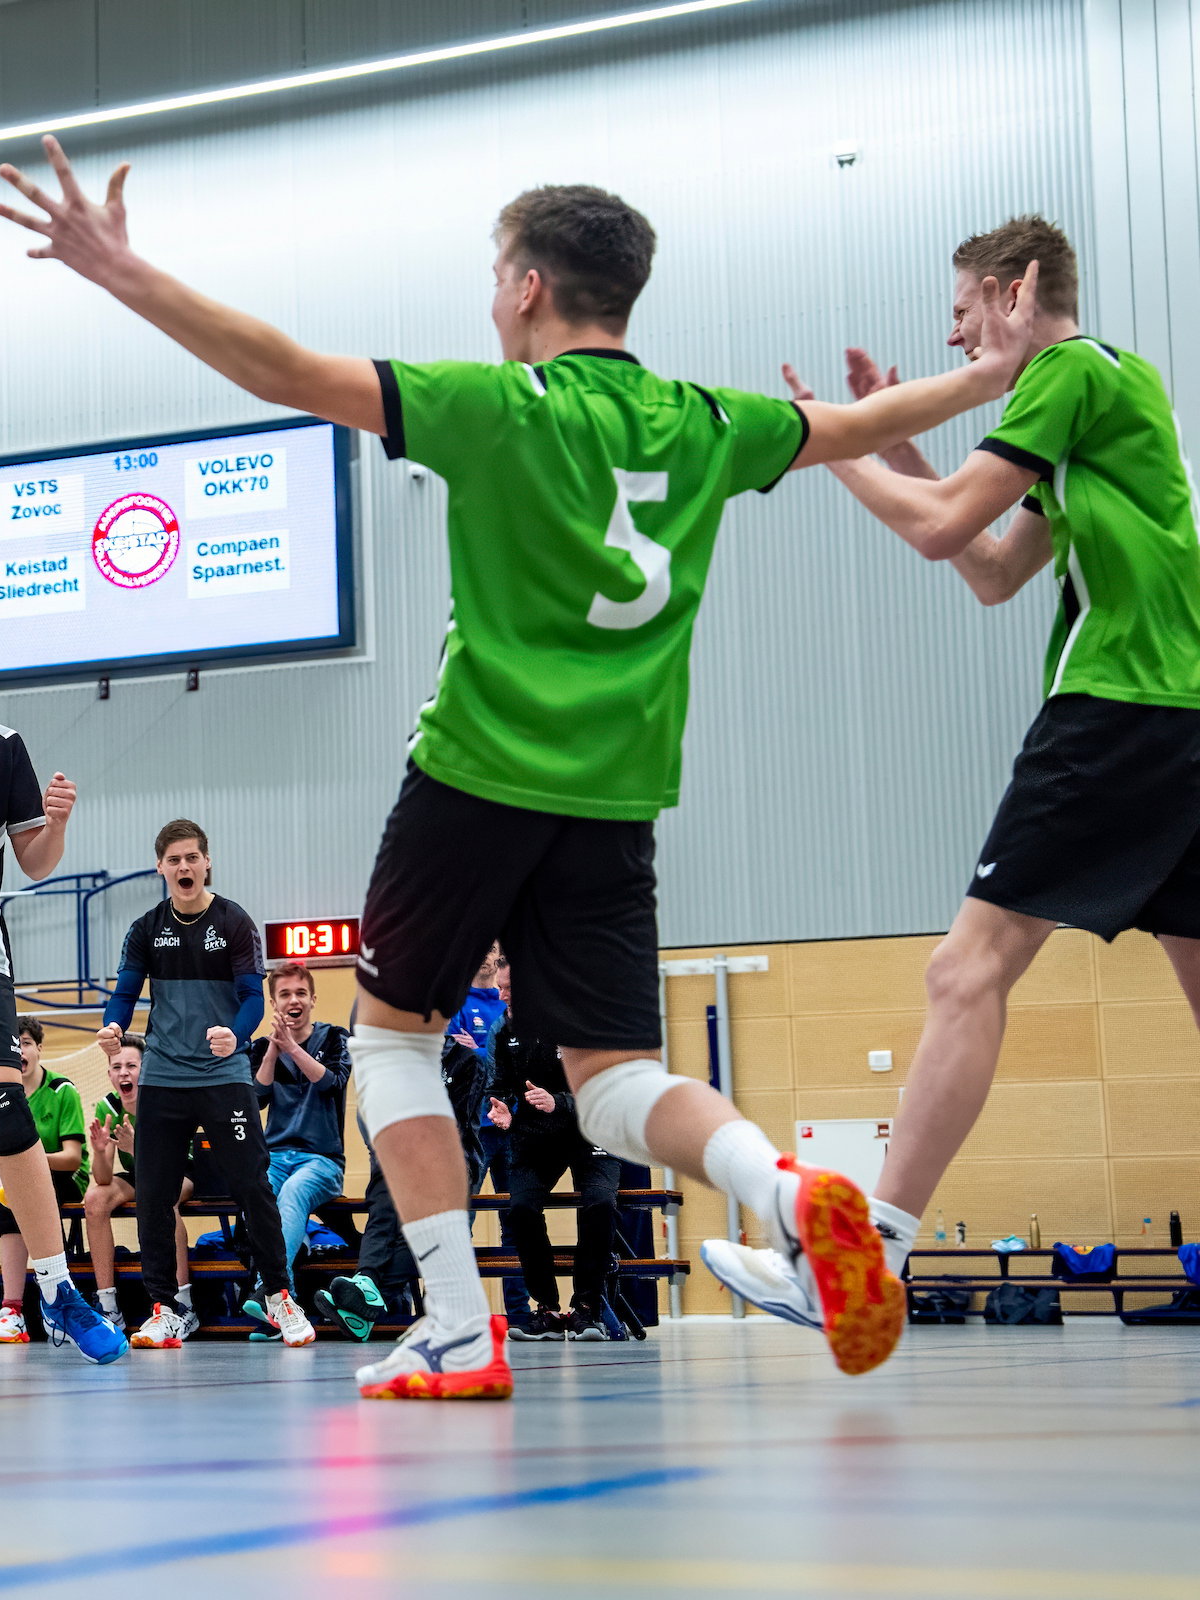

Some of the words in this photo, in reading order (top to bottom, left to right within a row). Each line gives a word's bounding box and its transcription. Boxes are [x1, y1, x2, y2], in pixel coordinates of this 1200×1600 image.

[114, 452, 158, 471] 13:00
[198, 454, 274, 475] VOLEVO
[14, 480, 58, 496] VSTS
[204, 475, 269, 496] OKK'70
[11, 504, 61, 519] Zovoc
[197, 537, 279, 556] Compaen
[586, 467, 671, 629] 5
[5, 556, 67, 576] Keistad
[193, 558, 285, 582] Spaarnest.
[154, 937, 180, 947] COACH
[286, 924, 349, 955] 10:31
[234, 1125, 246, 1140] 3
